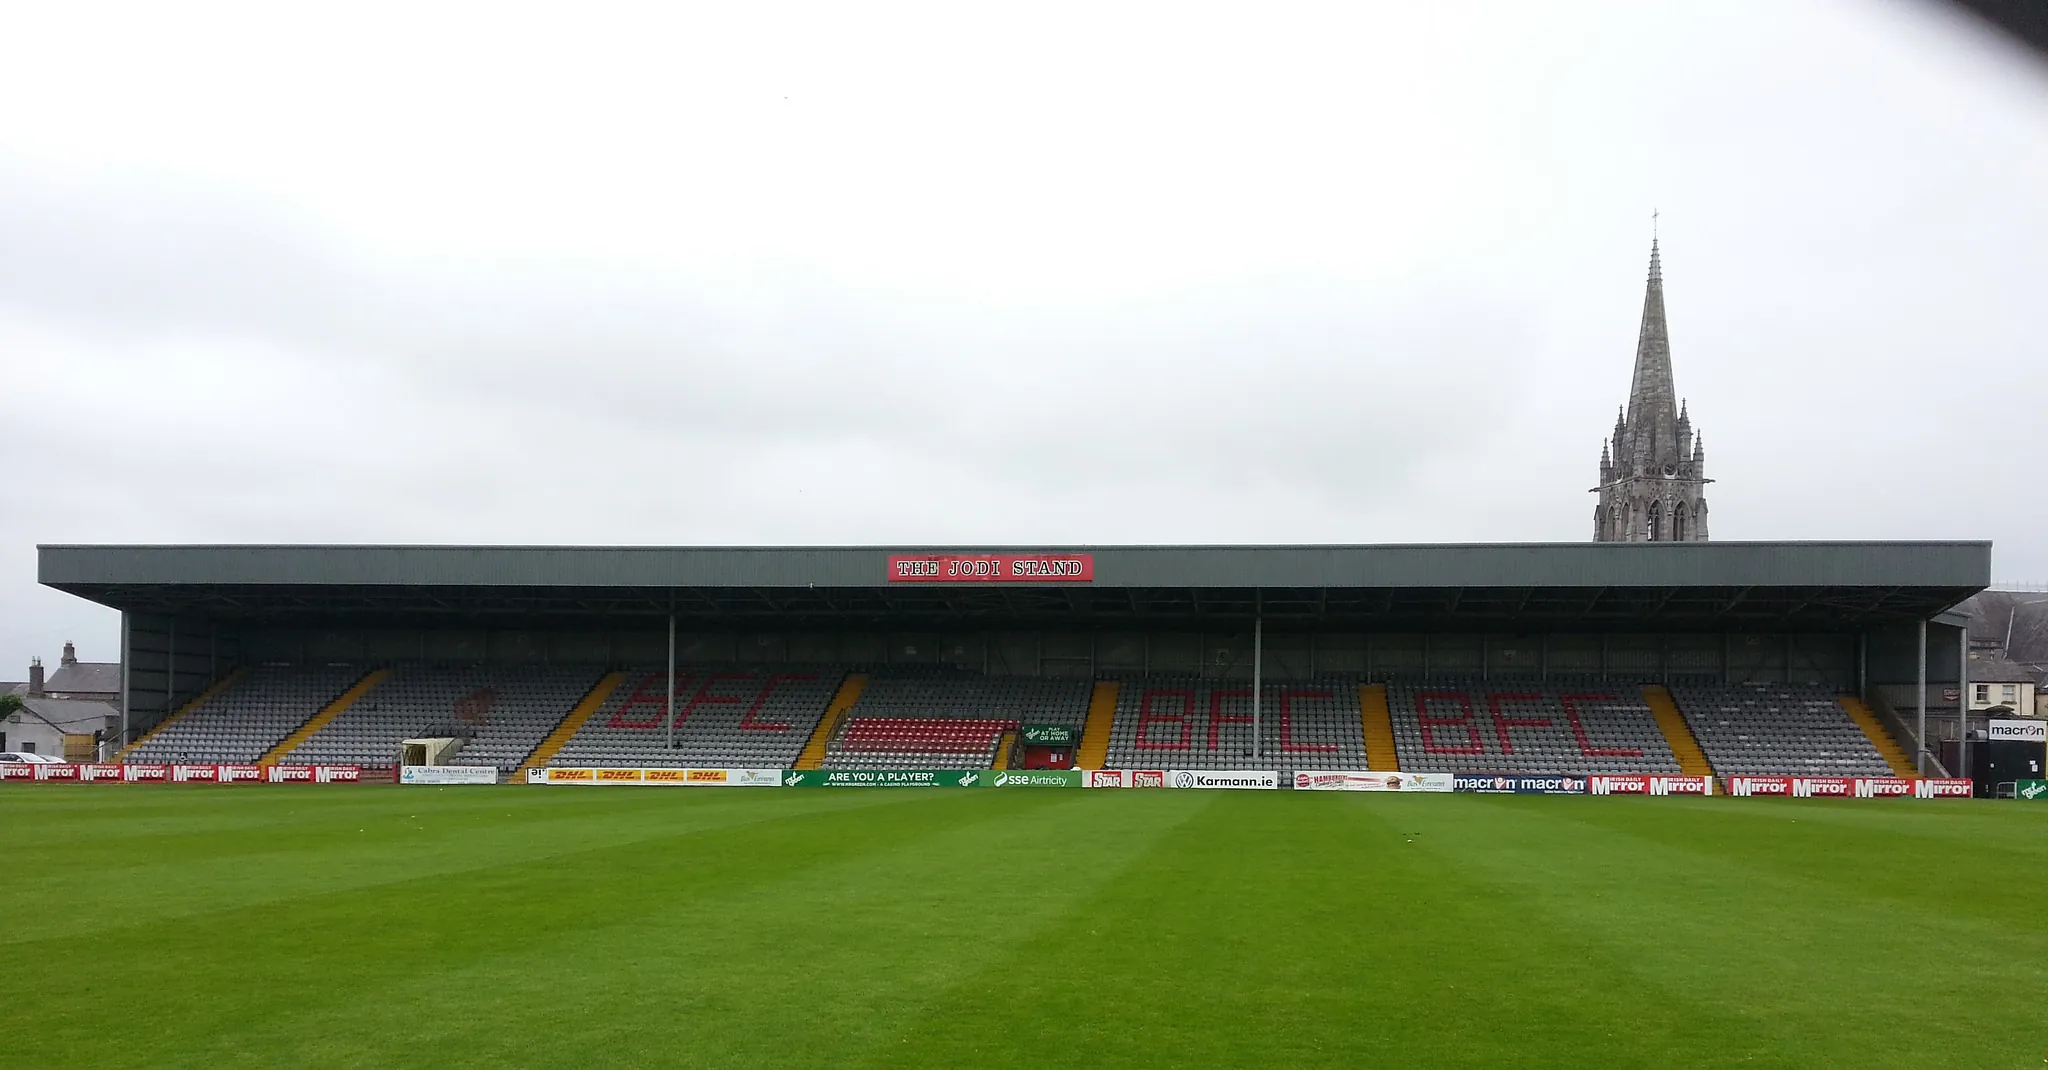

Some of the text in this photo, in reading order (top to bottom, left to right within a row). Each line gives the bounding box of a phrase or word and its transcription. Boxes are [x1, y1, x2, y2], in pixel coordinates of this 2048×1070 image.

[897, 561, 1083, 576] THE JODI STAND
[1136, 690, 1339, 751] BFC
[1415, 692, 1644, 756] BFC
[34, 765, 74, 780] Mirror
[80, 765, 120, 780] Mirror
[124, 765, 164, 781] Mirror
[173, 765, 214, 781] Mirror
[218, 766, 259, 782] Mirror
[268, 767, 311, 782] Mirror
[315, 767, 358, 782] Mirror
[555, 771, 586, 779] DHL
[603, 771, 634, 779] DHL
[693, 772, 721, 780] DHL
[829, 773, 934, 781] ARE YOU A PLAYER?
[1094, 772, 1120, 787] STAR
[1135, 772, 1160, 787] STAR
[1008, 775, 1067, 786] sse Airtricity
[1197, 776, 1273, 786] Karmann.ie
[1592, 777, 1645, 795] Mirror
[1650, 777, 1703, 795] Mirror
[1733, 778, 1787, 796] Mirror
[1793, 779, 1847, 797] Mirror
[1855, 779, 1910, 798] Mirror
[1915, 780, 1970, 799] Mirror
